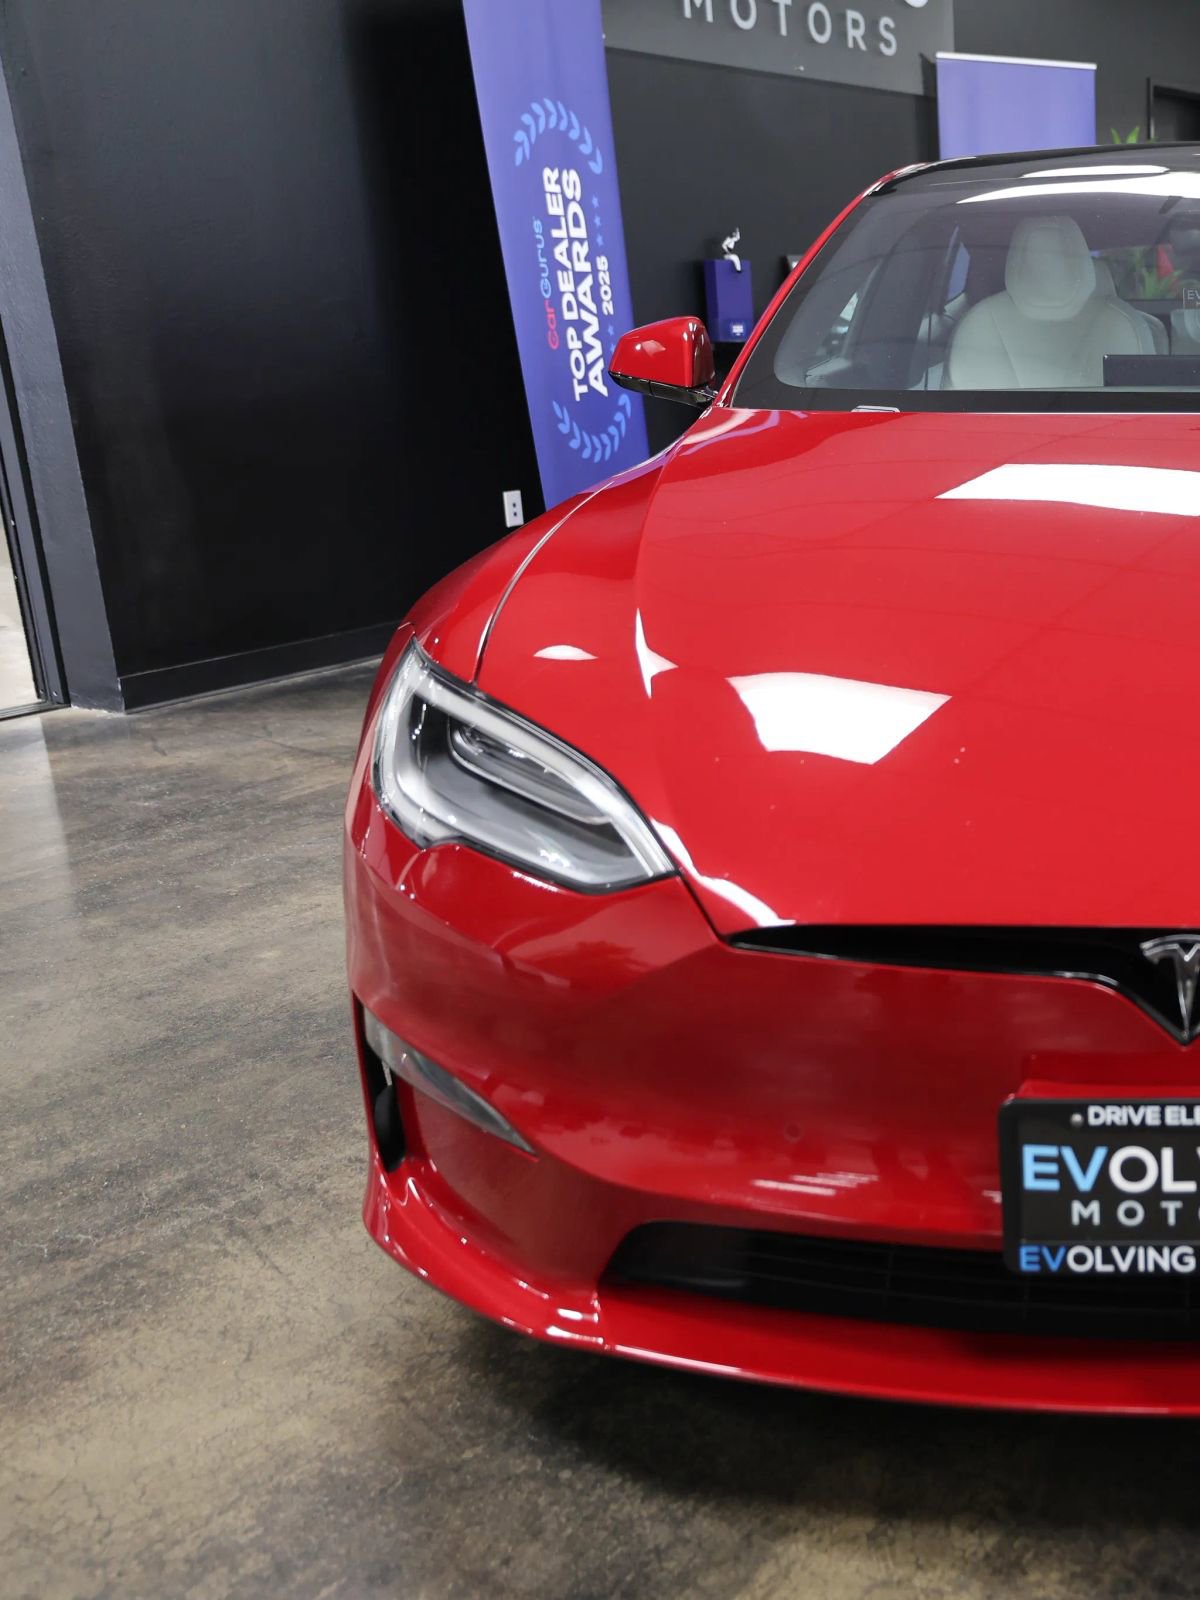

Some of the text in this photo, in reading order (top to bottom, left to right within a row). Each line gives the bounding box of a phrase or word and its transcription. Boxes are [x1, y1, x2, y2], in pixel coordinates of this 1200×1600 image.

[542, 167, 588, 401] TOP DEALER
[561, 168, 608, 397] AWARDS
[596, 255, 614, 316] 2025
[1088, 1105, 1161, 1126] DRIVE
[1019, 1245, 1196, 1273] EVOLVING
